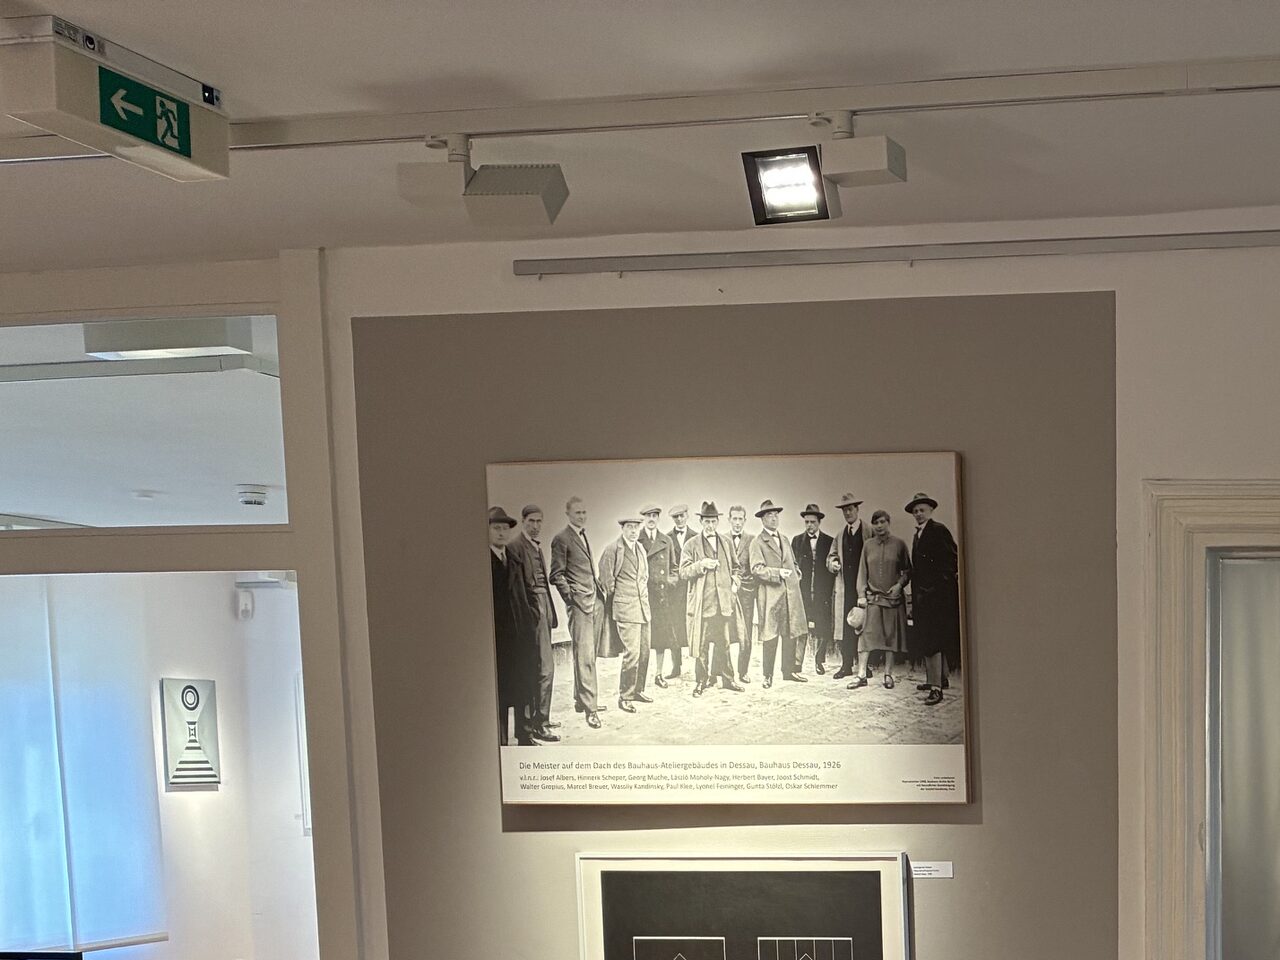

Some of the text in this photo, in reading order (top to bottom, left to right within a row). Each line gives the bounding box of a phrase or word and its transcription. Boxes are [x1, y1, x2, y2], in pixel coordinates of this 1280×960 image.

[519, 761, 842, 770] Die Meister auf dem Dach des Bauhaus-Ateliergebäudes in Dessau, Bauhaus Dessau, 1926
[628, 774, 647, 782] Georg
